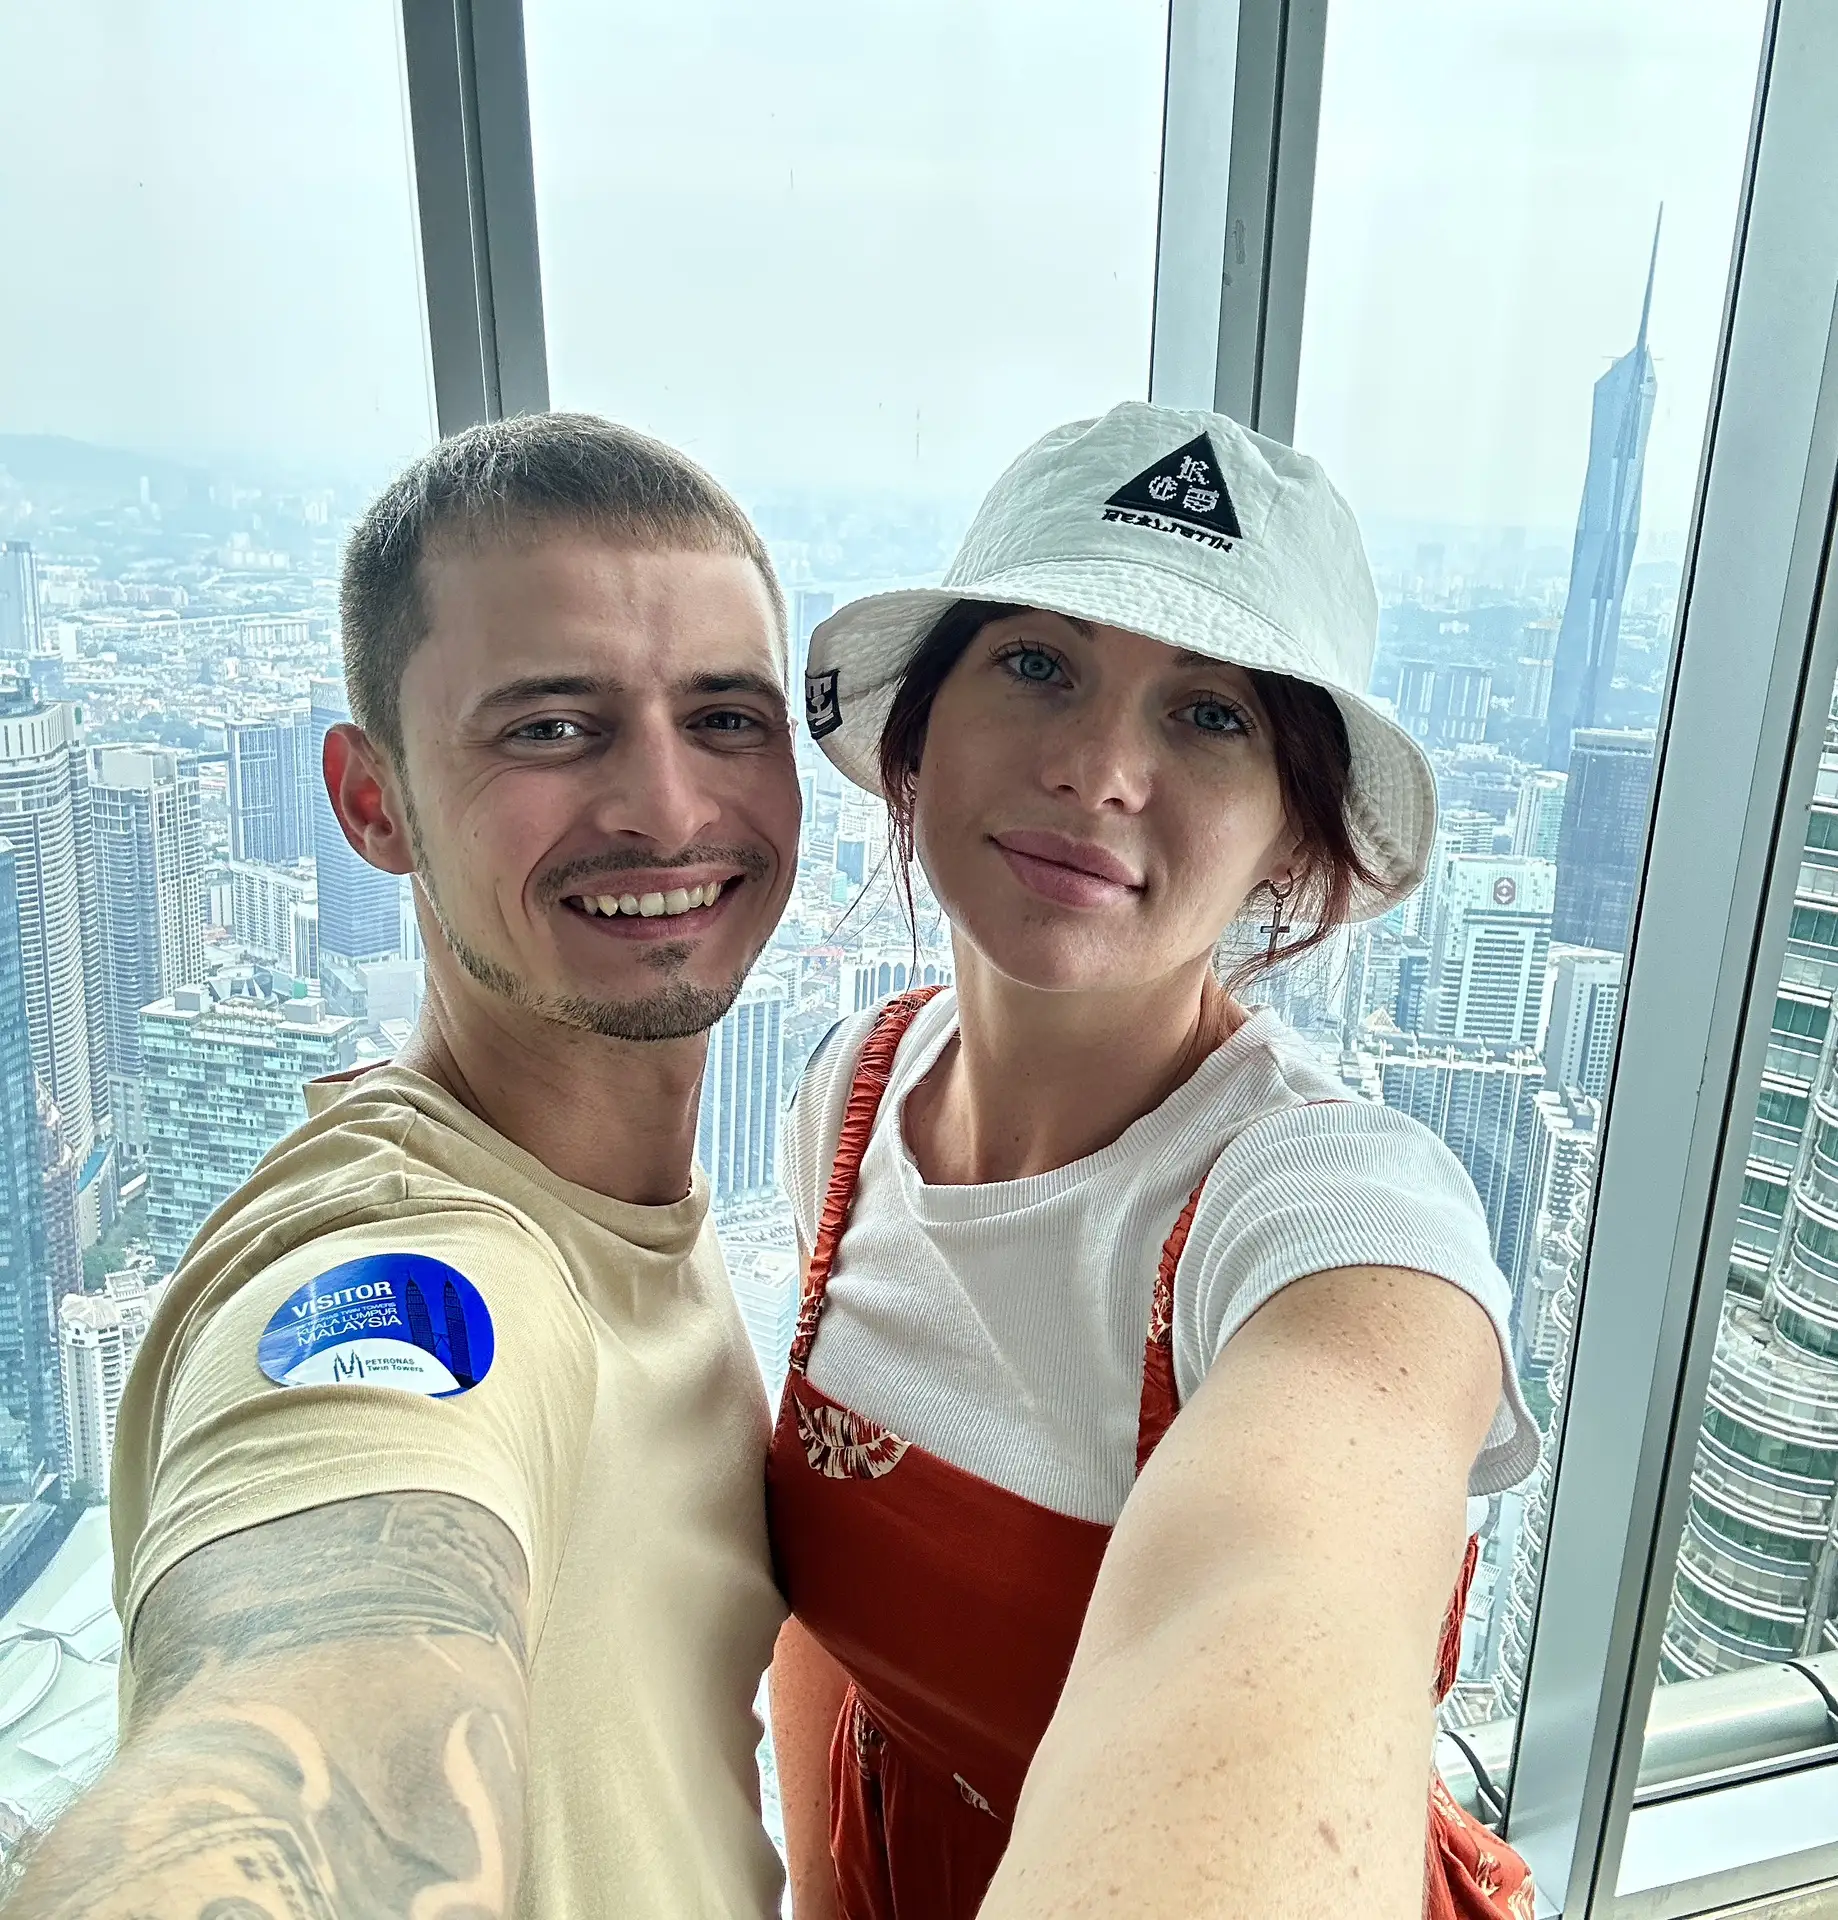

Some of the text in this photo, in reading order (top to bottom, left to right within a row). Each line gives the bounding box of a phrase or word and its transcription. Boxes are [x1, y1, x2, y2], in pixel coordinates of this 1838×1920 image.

[292, 1281, 393, 1319] VISITOR
[297, 1307, 398, 1337] KUALA LUMPUR
[298, 1314, 403, 1347] MALAYSIA
[365, 1357, 415, 1366] PETRONAS
[391, 1364, 424, 1373] Towers
